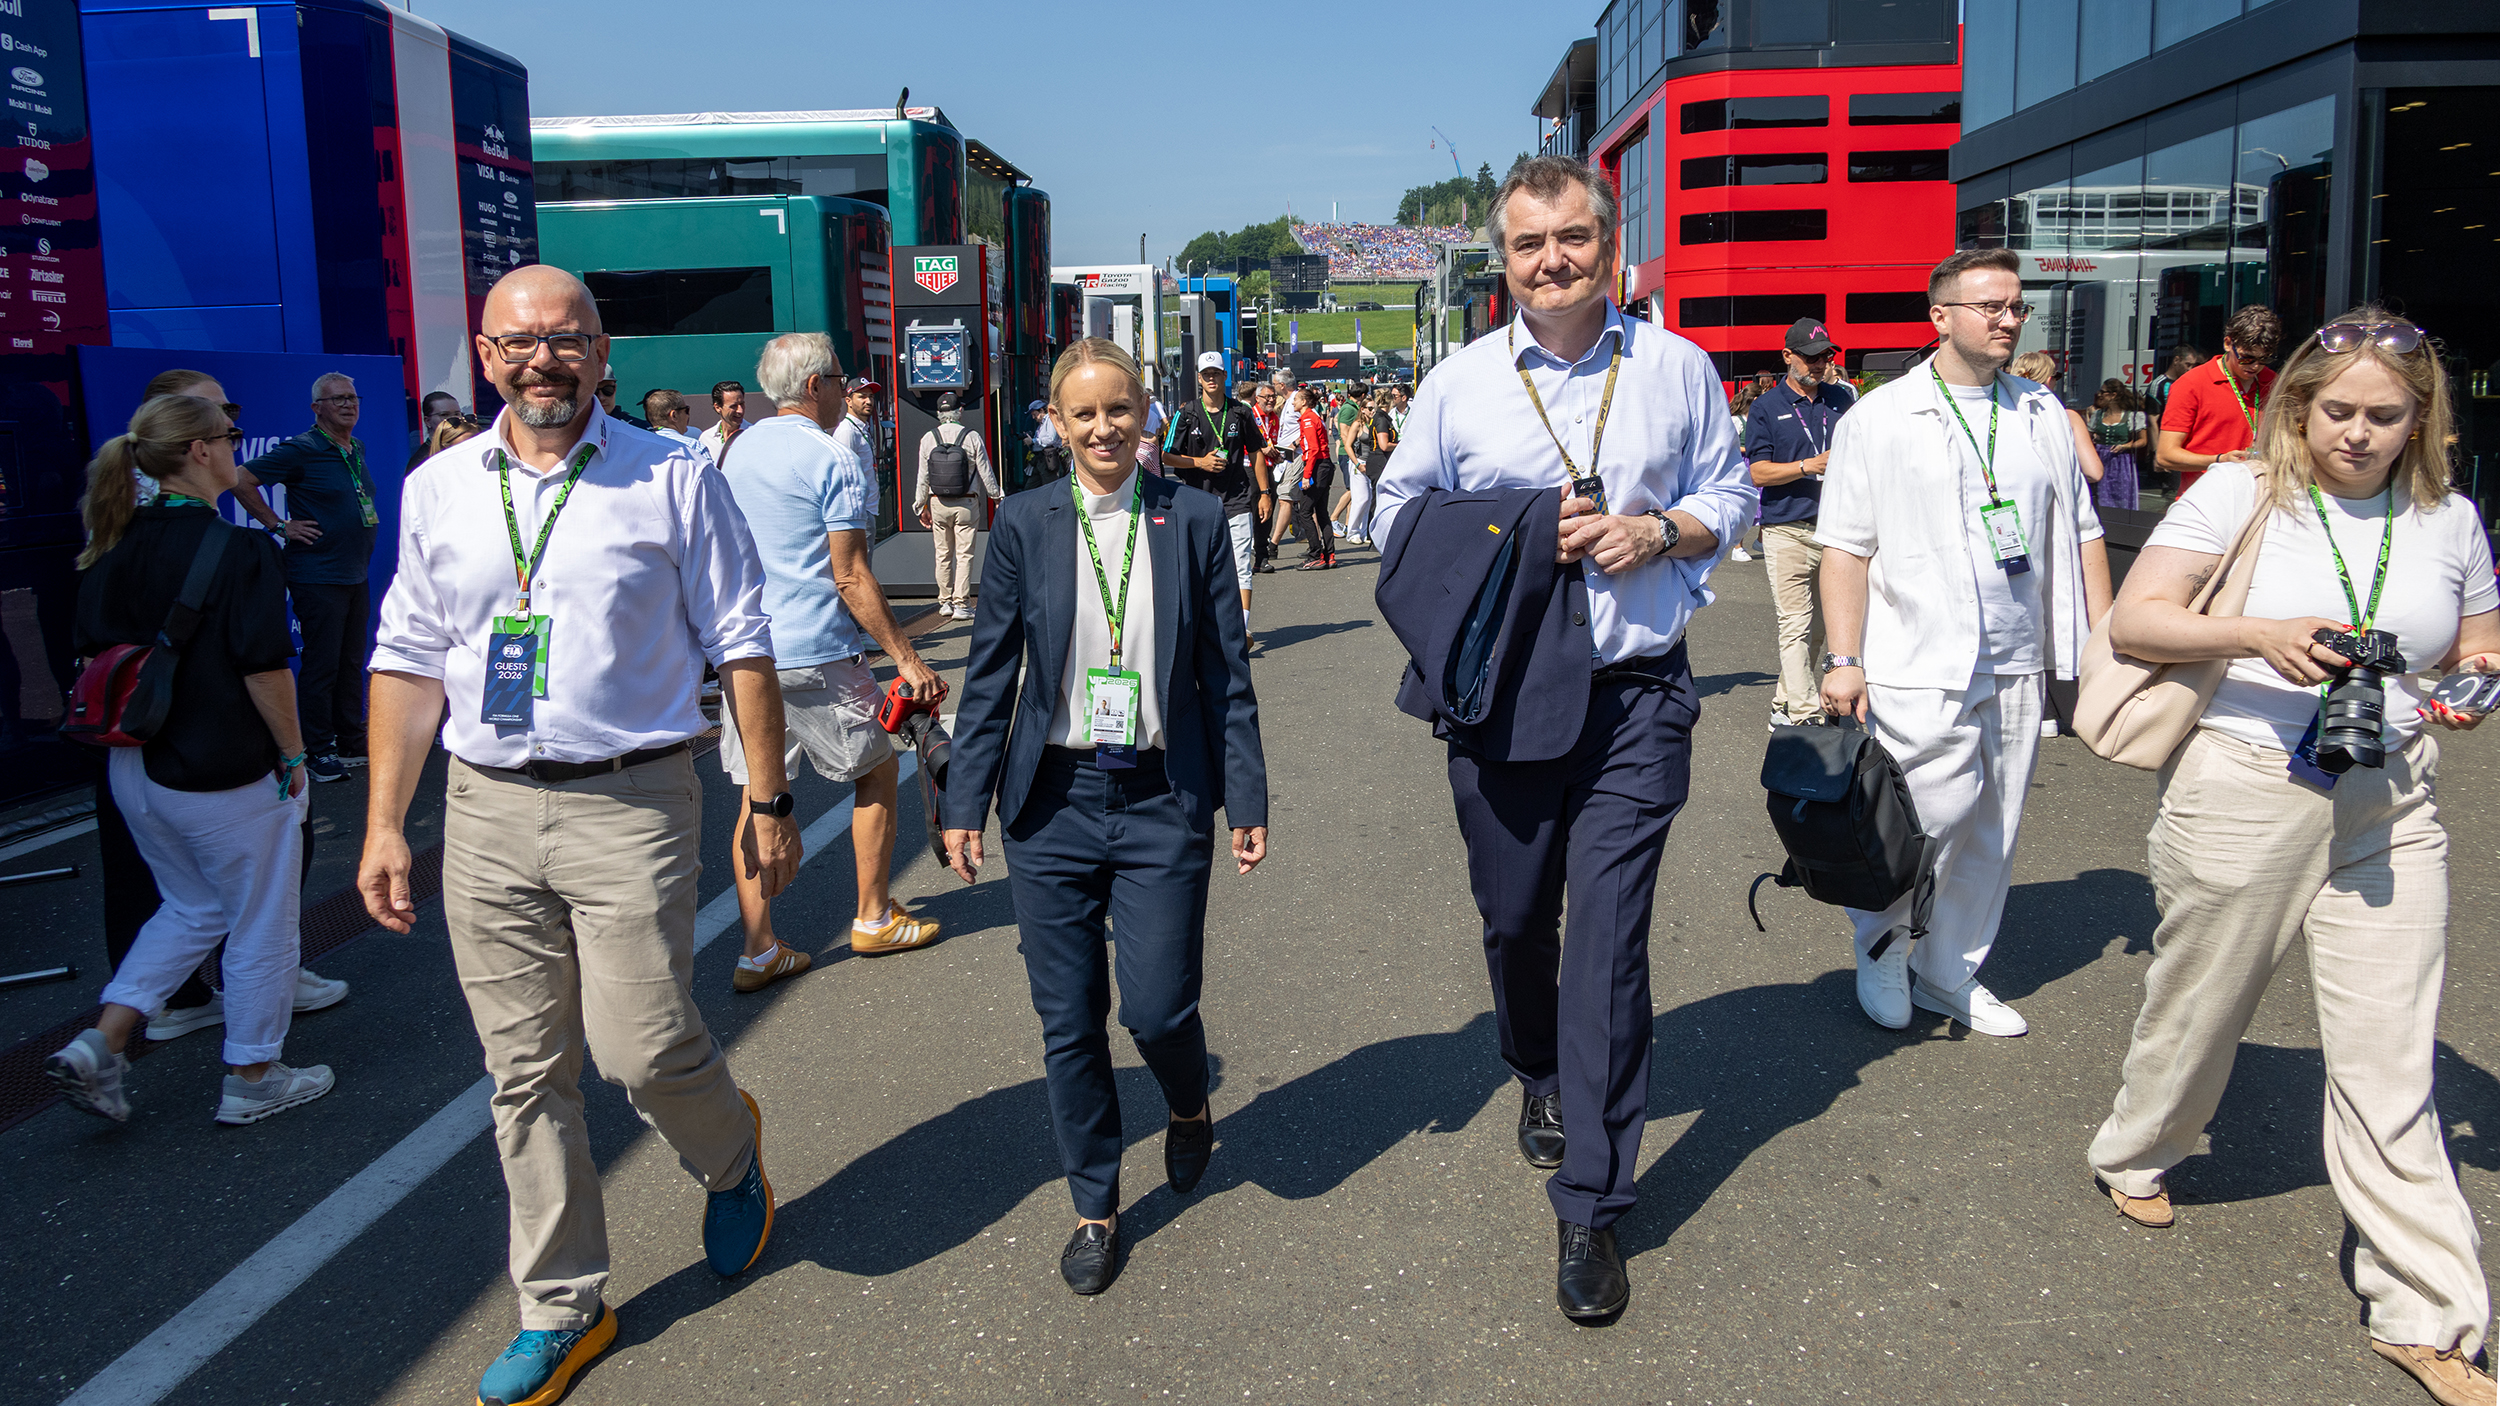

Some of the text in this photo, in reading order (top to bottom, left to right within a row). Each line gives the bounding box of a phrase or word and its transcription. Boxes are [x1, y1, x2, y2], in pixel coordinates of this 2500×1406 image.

[15, 40, 48, 58] Cash App
[18, 69, 37, 84] Ford
[11, 83, 47, 97] RACING
[8, 98, 26, 110] Mobil
[34, 104, 52, 115] Mobil
[17, 135, 51, 150] TUDOR
[482, 140, 509, 160] Red Bull
[476, 162, 495, 180] VISA
[478, 201, 497, 214] HUGO
[918, 258, 954, 271] TAG
[30, 268, 64, 284] Airtasker
[917, 272, 956, 292] HEUER
[1074, 279, 1099, 288] GR
[32, 289, 66, 304] PIRELLI
[242, 436, 288, 462] VIS
[503, 646, 522, 656] FIA
[494, 662, 528, 671] GUESTS
[2374, 662, 2391, 670] SONY
[498, 671, 523, 680] 2026
[1107, 677, 1138, 687] 2026
